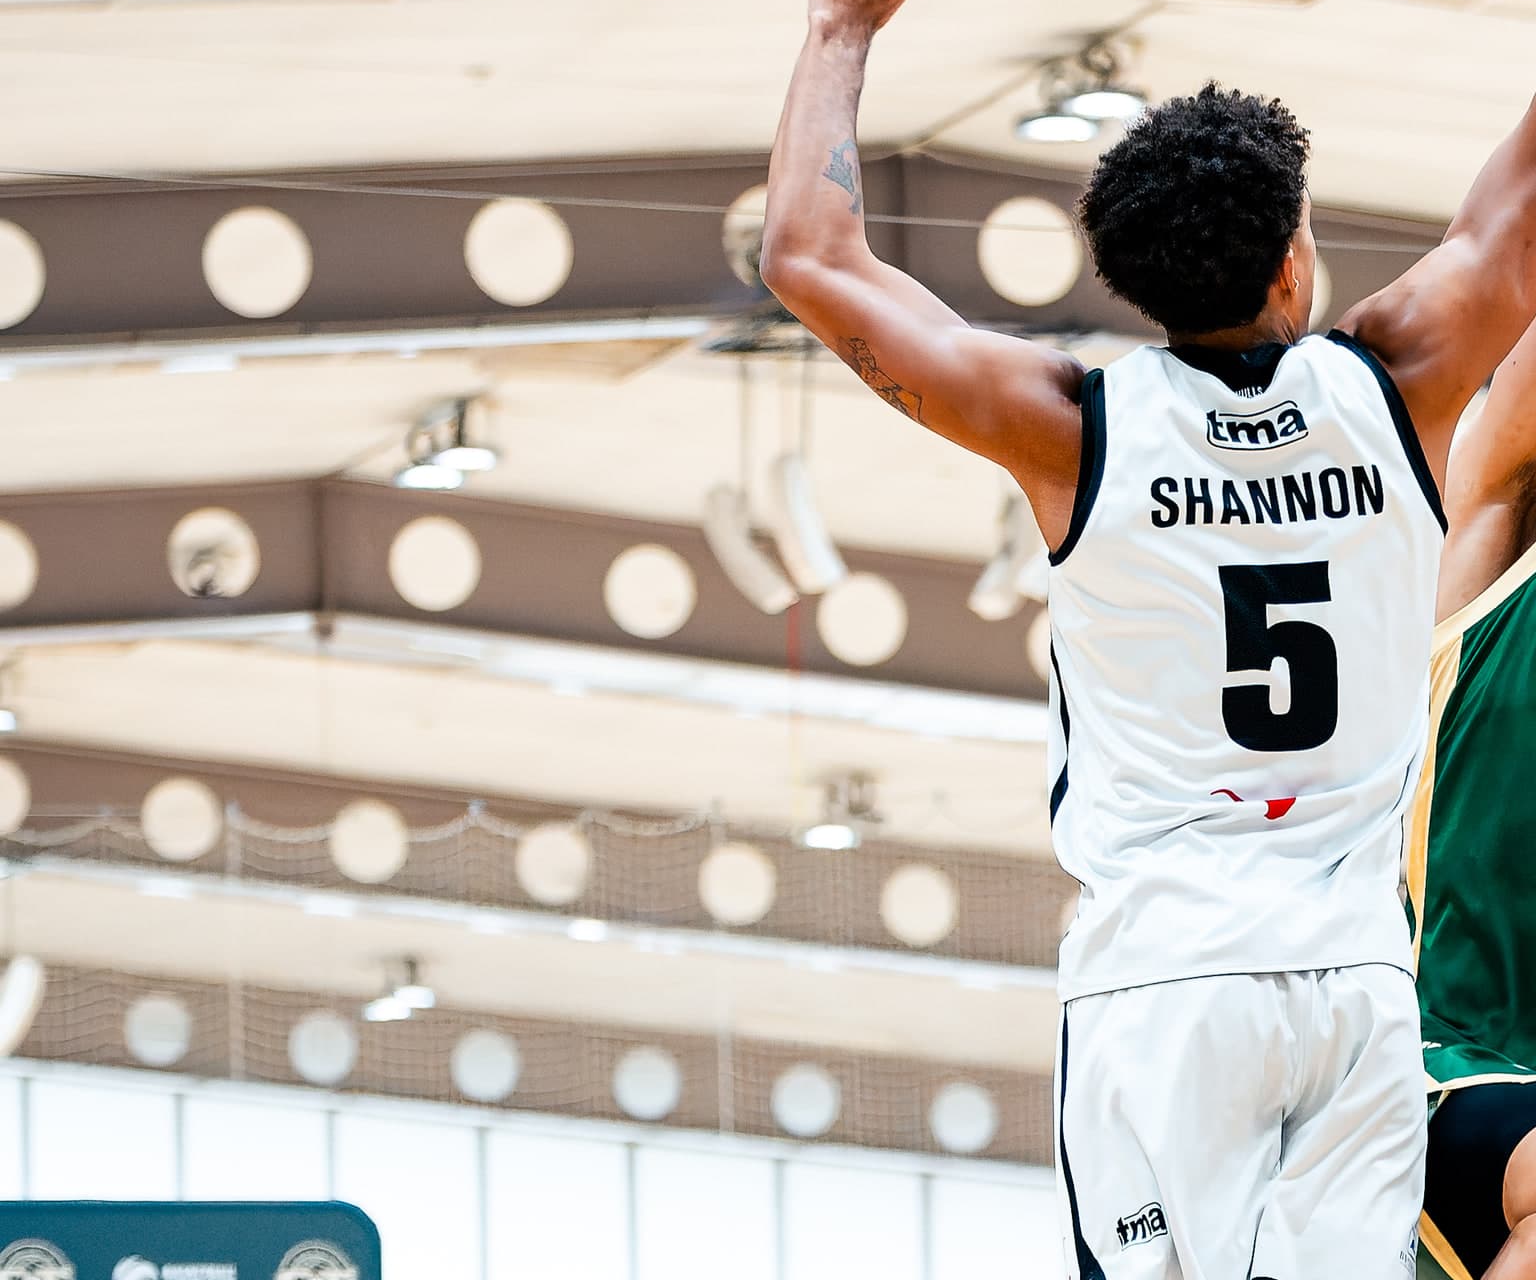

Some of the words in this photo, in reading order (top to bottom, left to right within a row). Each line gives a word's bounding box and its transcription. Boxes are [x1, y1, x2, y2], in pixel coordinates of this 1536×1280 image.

[1206, 408, 1308, 444] tma
[1150, 464, 1385, 529] SHANNON
[1218, 561, 1338, 752] 5
[1116, 1207, 1167, 1246] tma
